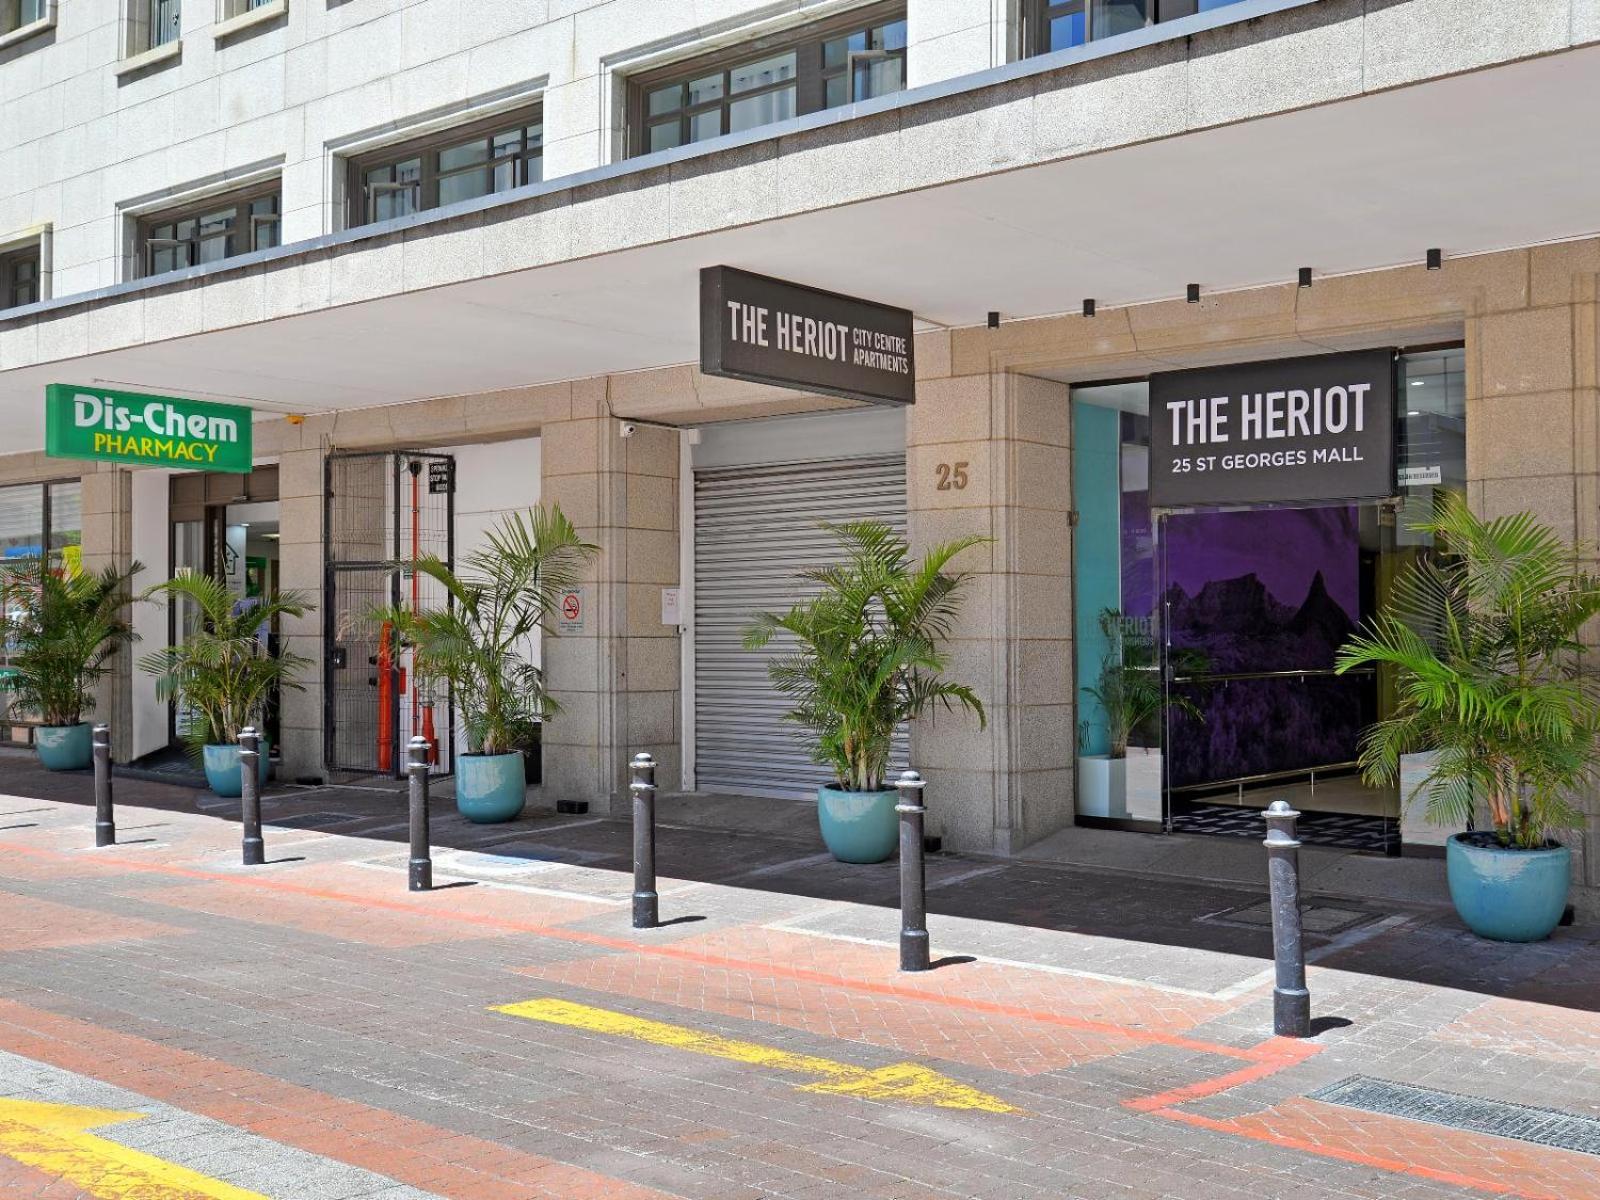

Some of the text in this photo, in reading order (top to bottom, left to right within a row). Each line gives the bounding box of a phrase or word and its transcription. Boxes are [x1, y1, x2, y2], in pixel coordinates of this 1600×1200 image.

[727, 300, 849, 363] THE HERIOT
[852, 327, 907, 355] CITY CENTRE
[853, 348, 909, 375] APARTMENTS
[73, 393, 238, 443] Dis-Chem
[1166, 383, 1371, 446] THE HERIOT
[94, 432, 218, 463] PHARMACY
[1172, 446, 1364, 474] 25 ST GEORGES MALL
[935, 461, 969, 490] 25
